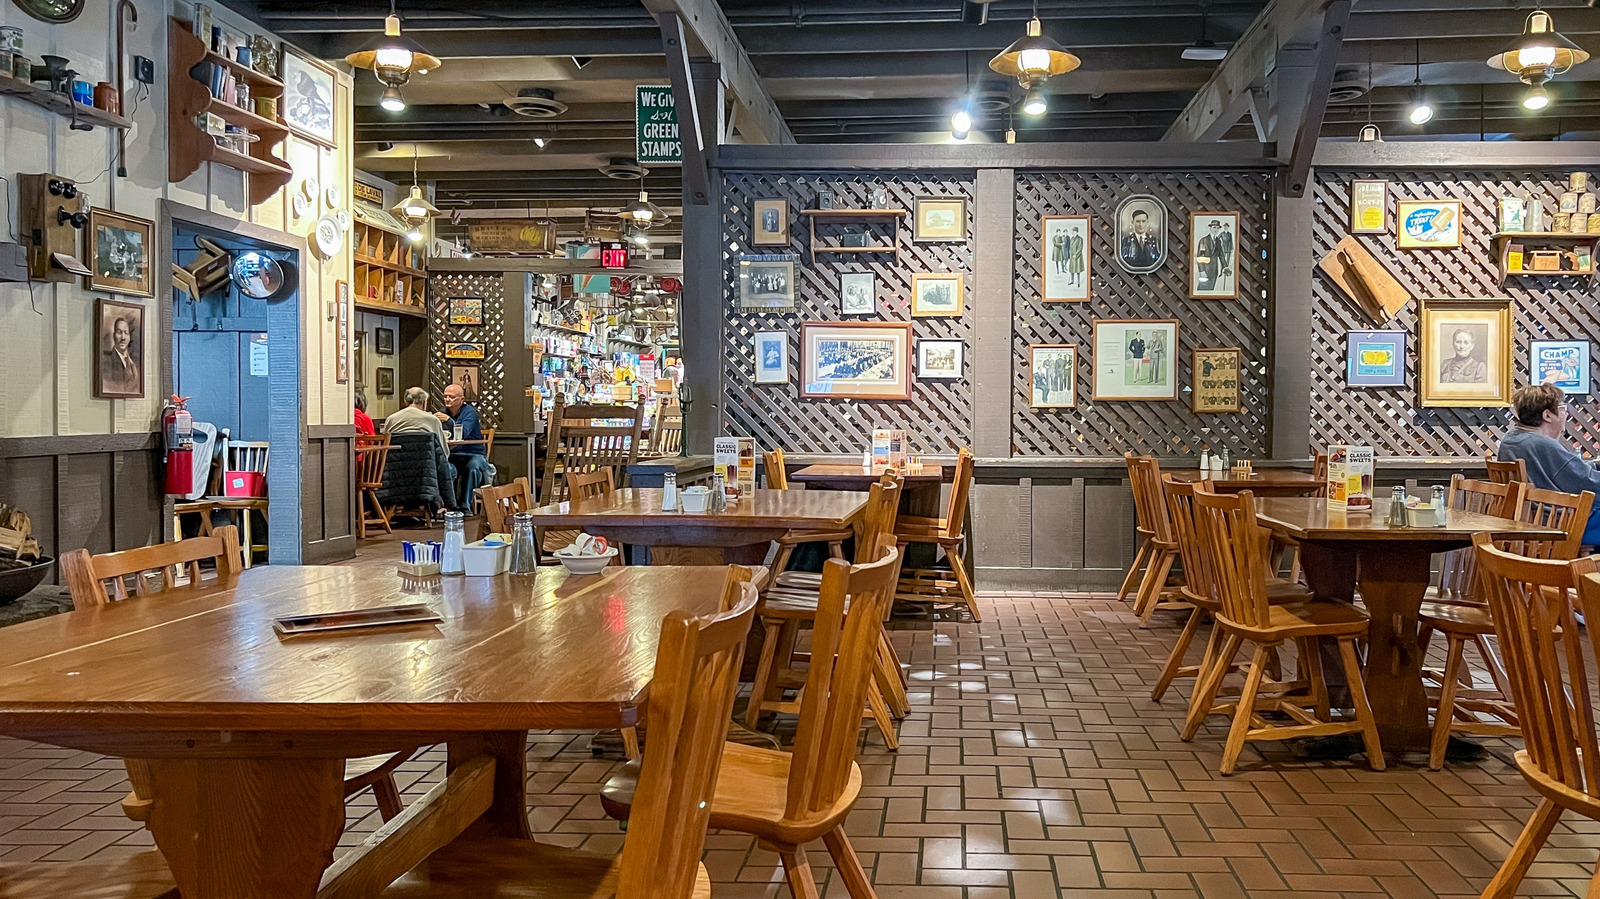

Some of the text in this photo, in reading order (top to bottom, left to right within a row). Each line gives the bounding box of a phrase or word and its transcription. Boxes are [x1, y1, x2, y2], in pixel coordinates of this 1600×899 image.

[641, 92, 675, 107] WE GIV
[643, 123, 679, 138] GREEN
[641, 141, 682, 157] STAMPS
[358, 185, 366, 193] DE
[366, 187, 382, 199] LAVAL
[602, 249, 626, 267] EXIT
[1544, 350, 1574, 358] CHAMP
